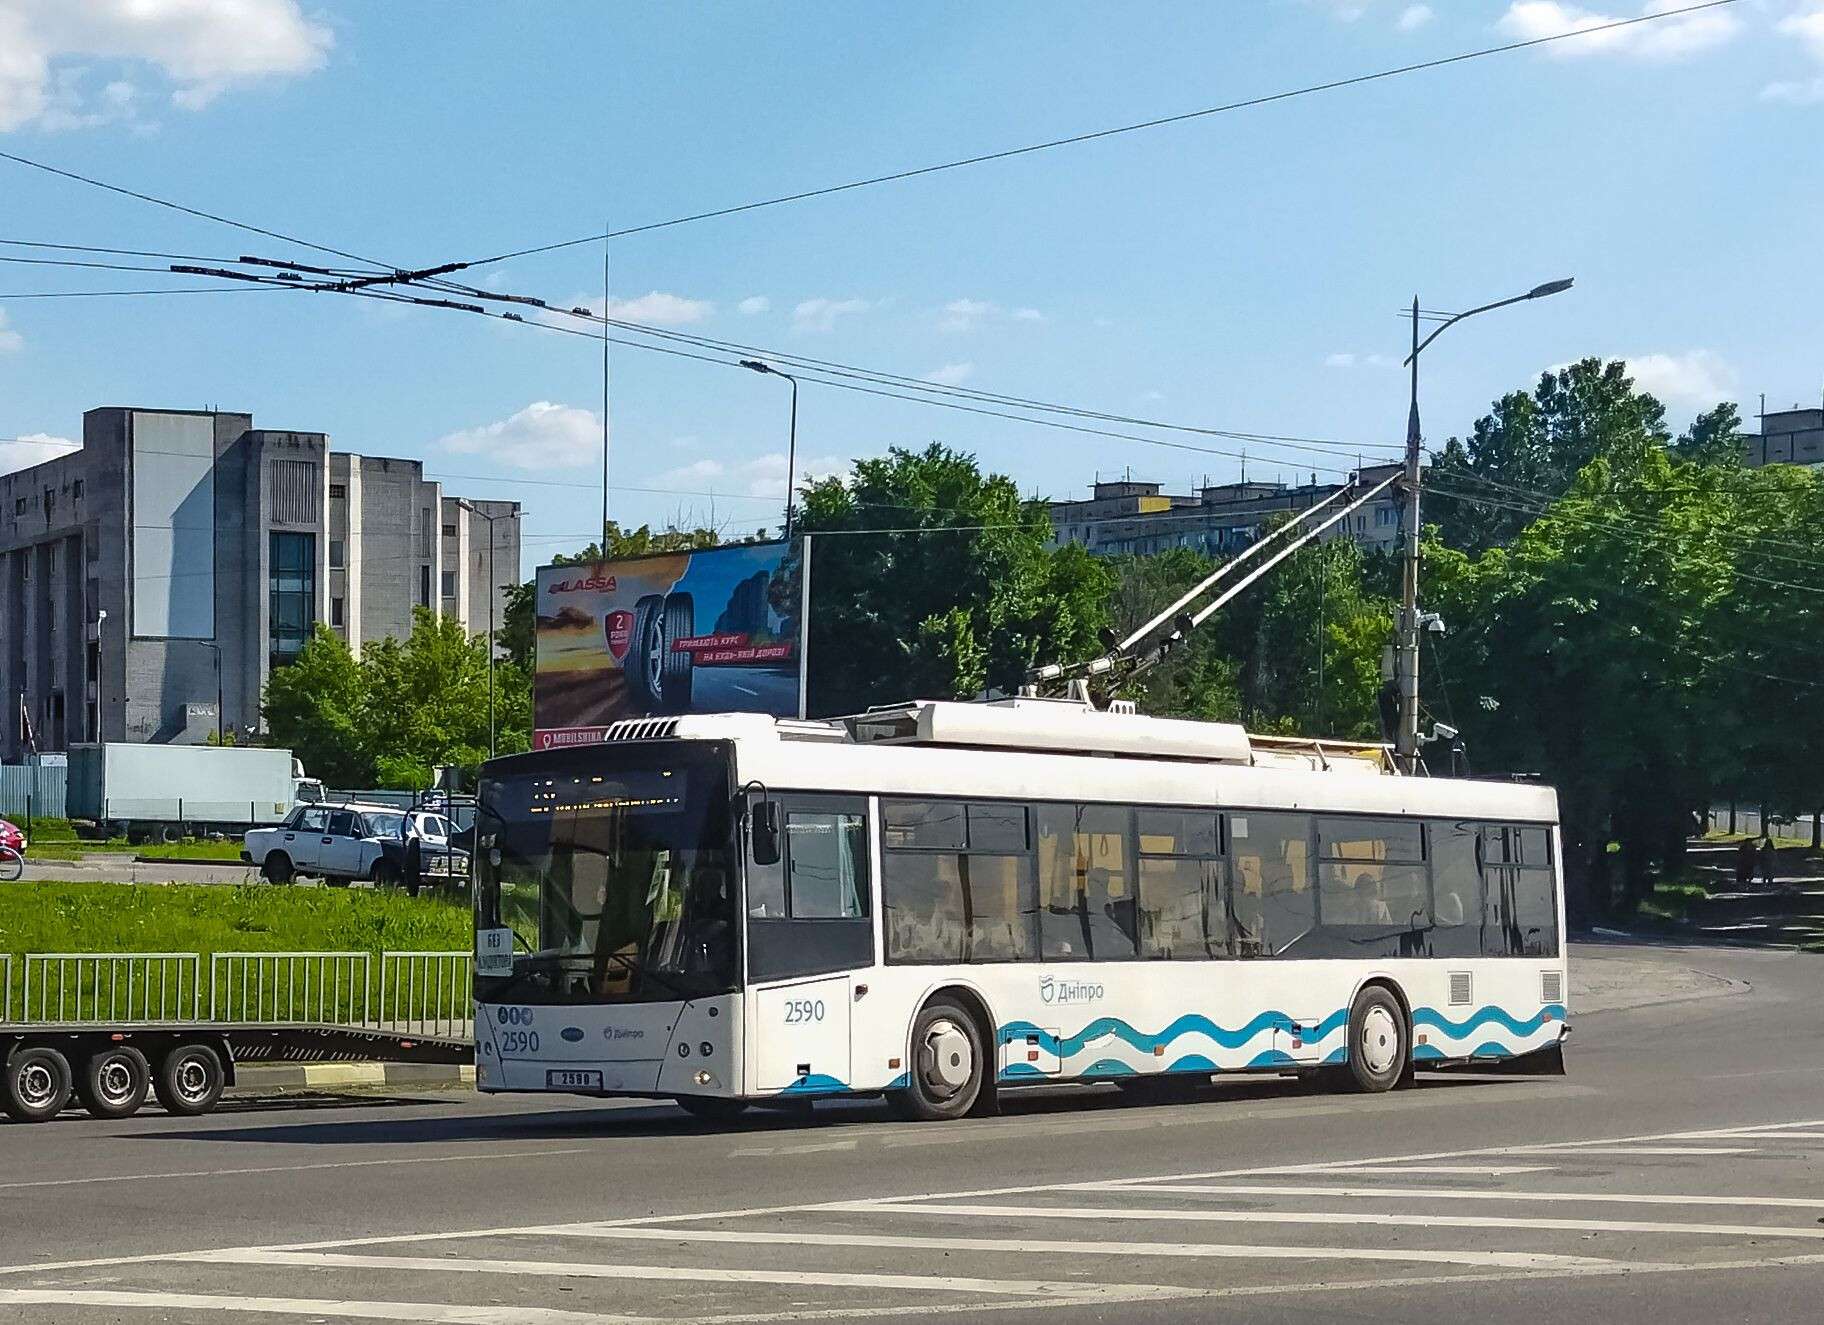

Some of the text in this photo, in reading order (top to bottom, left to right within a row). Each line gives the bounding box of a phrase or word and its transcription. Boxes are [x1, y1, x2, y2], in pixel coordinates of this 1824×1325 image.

[559, 576, 617, 592] LASSA
[616, 615, 624, 630] 2
[1057, 982, 1104, 1002] Дніпро
[785, 1000, 825, 1022] 2590
[502, 1031, 540, 1052] 2590
[562, 1073, 590, 1085] 2590
